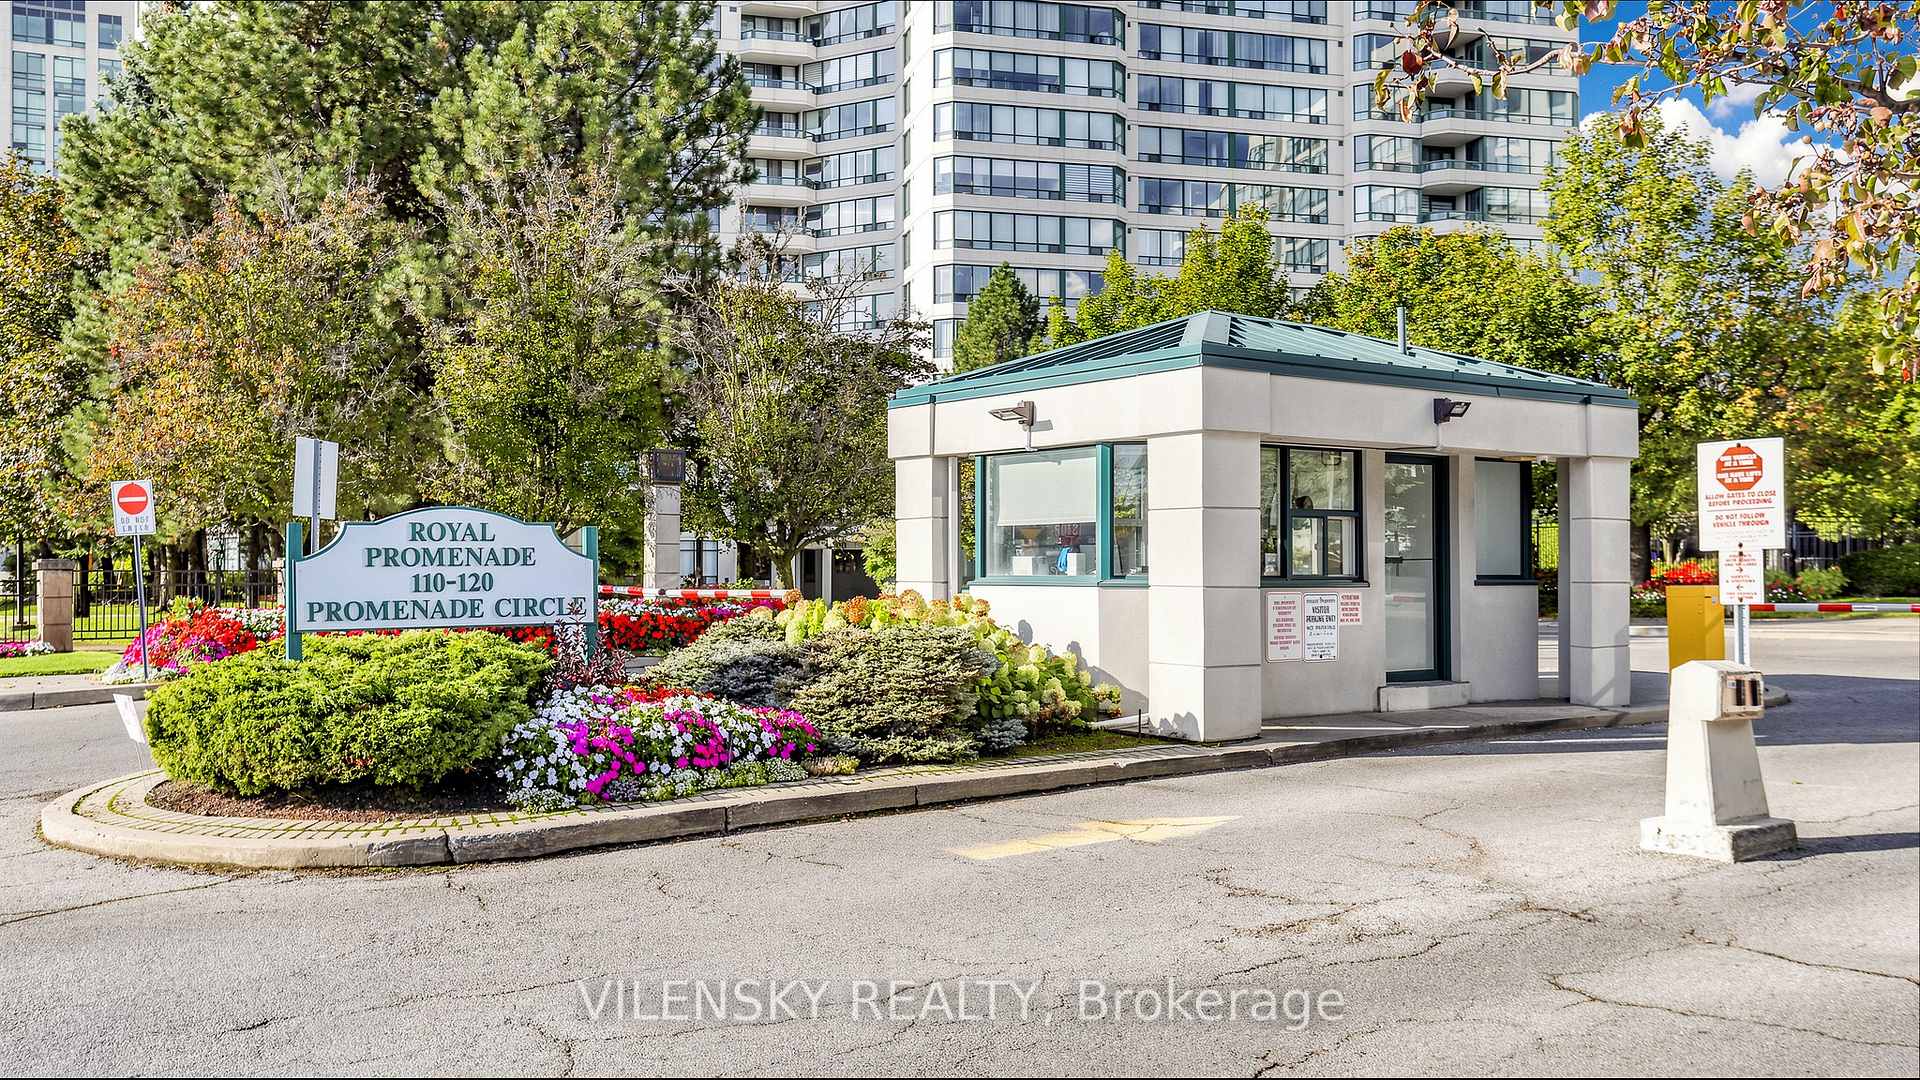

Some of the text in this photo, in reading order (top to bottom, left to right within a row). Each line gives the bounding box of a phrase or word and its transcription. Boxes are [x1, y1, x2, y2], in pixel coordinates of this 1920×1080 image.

[408, 522, 496, 542] ROYAL
[364, 547, 537, 567] PROMENADE
[411, 572, 494, 593] 110-120
[306, 597, 587, 623] PROMENADE CIRCLE
